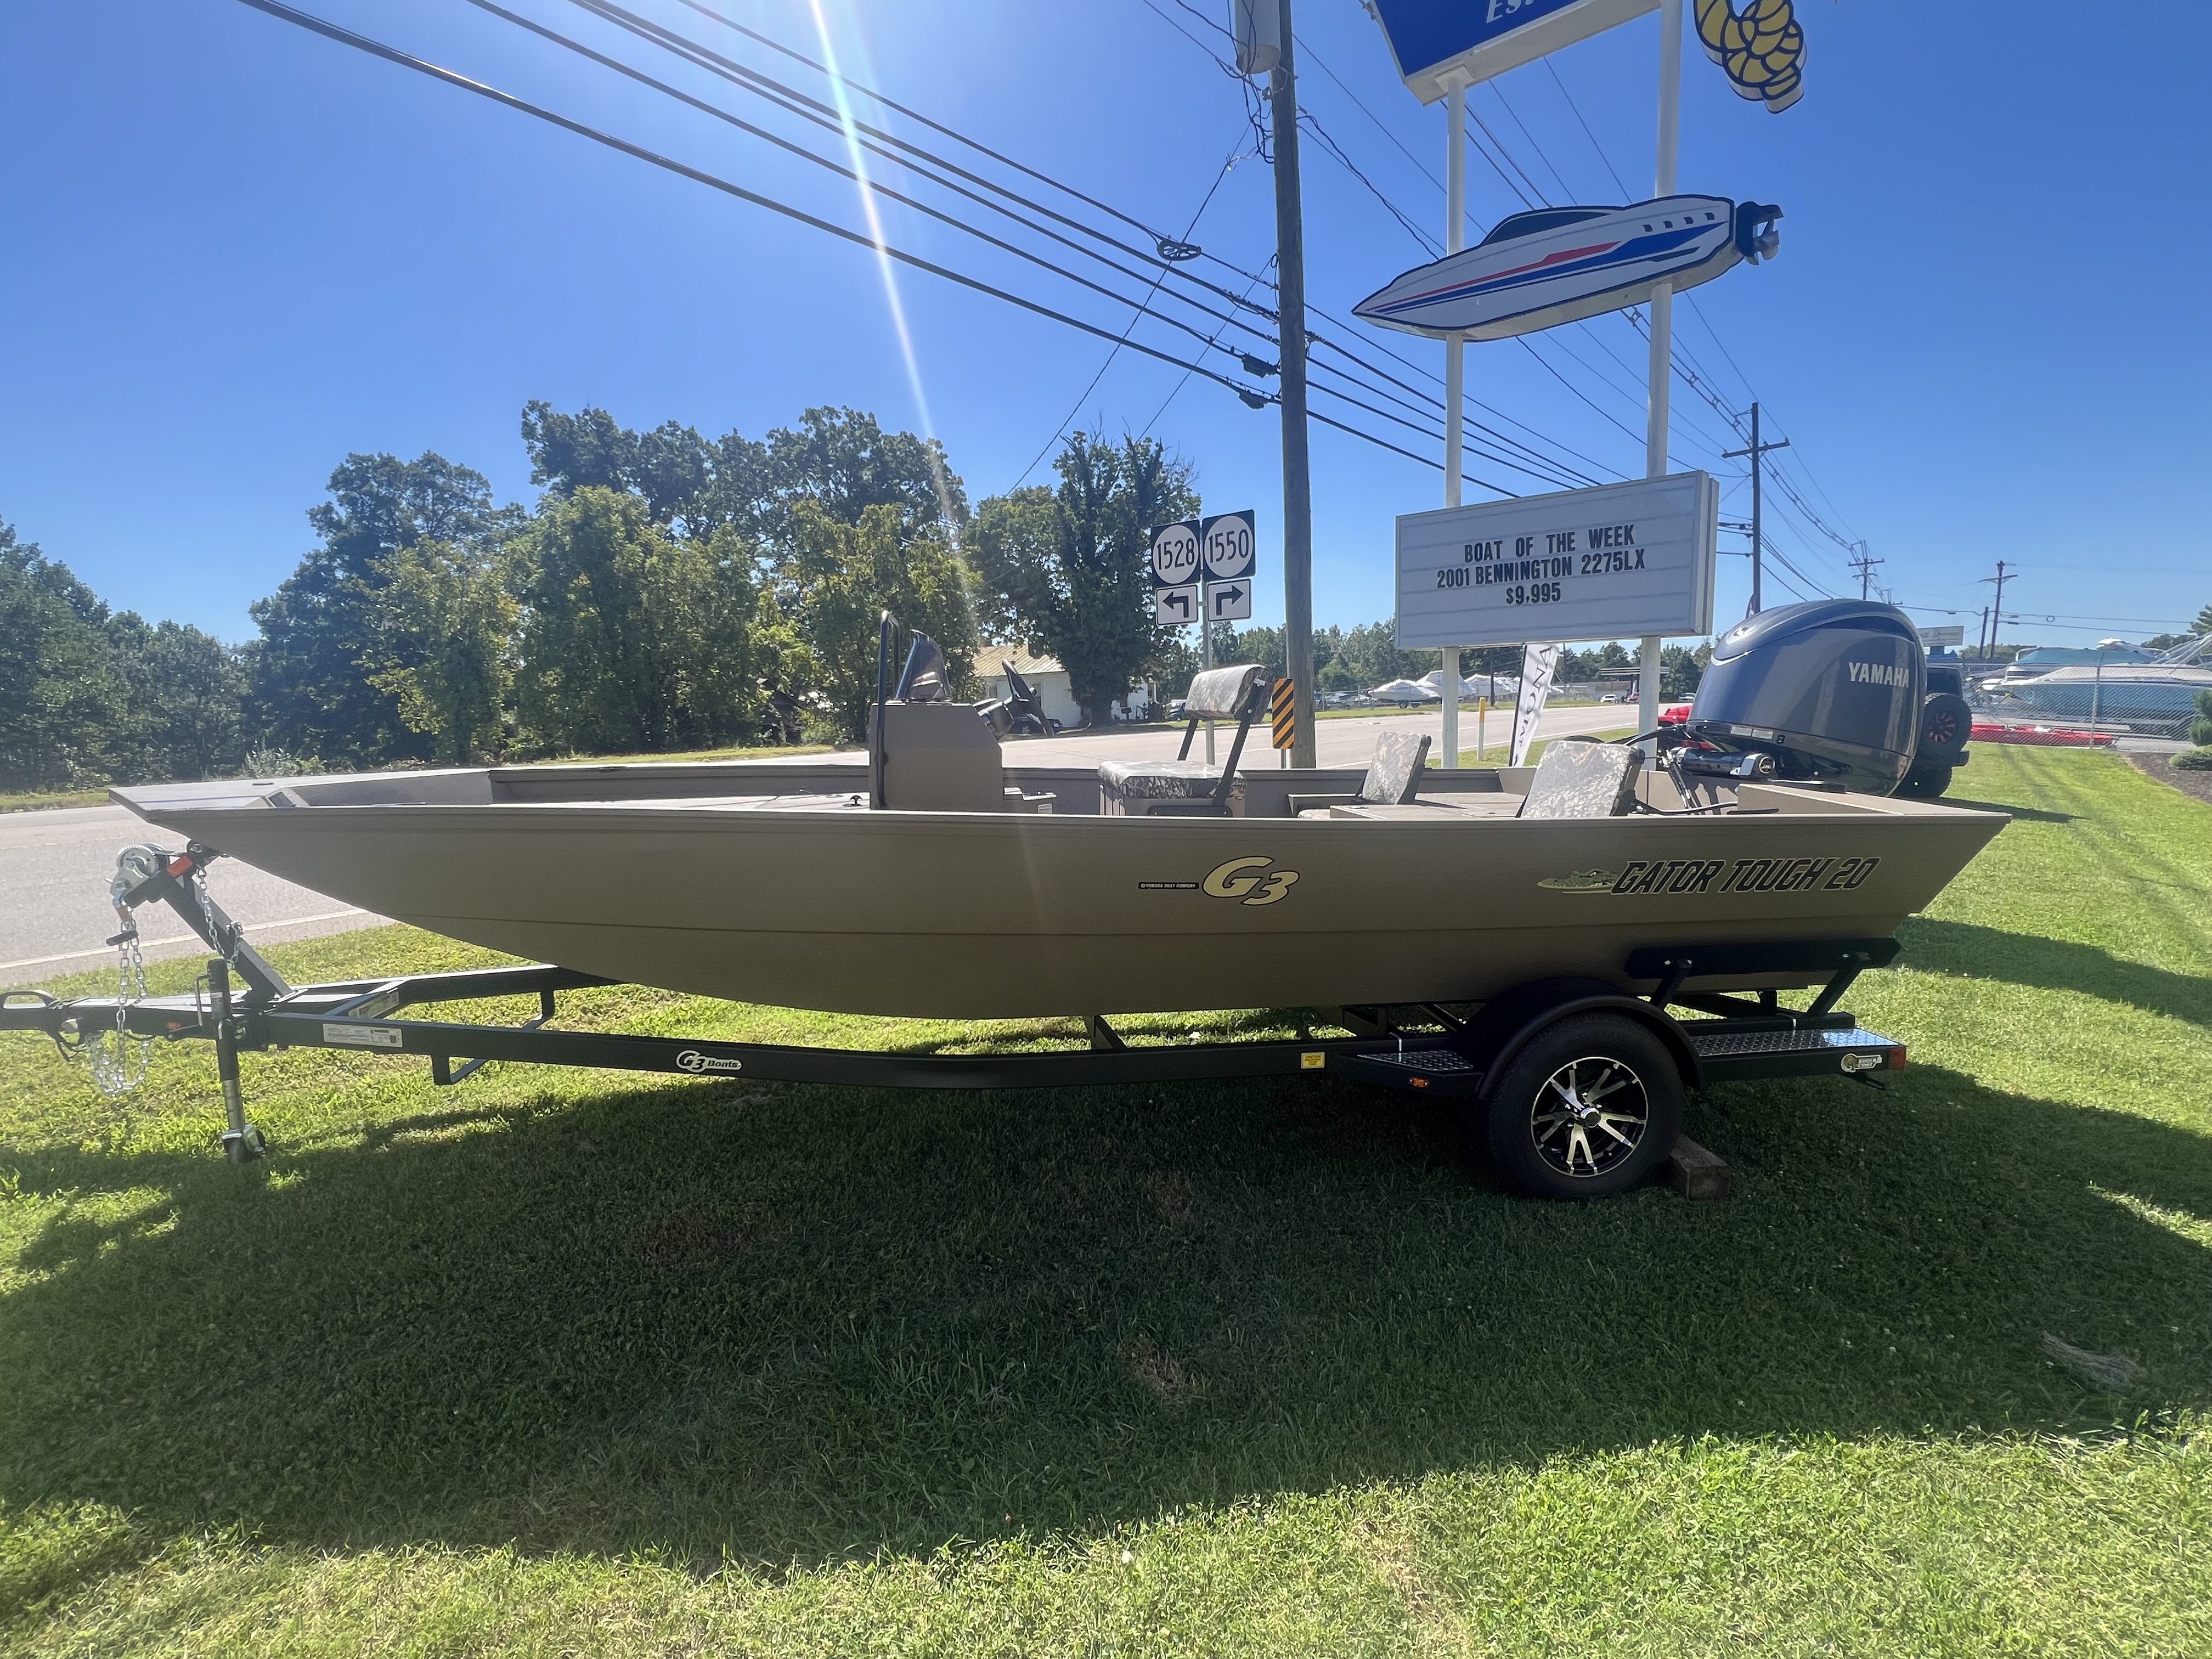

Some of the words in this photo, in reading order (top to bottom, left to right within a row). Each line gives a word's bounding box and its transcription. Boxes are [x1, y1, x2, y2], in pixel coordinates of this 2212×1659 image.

[1157, 538, 1195, 570] 1528
[1209, 529, 1249, 563] 1550
[1465, 540, 1503, 563] BOAT
[1515, 537, 1533, 557] OF
[1546, 532, 1576, 554] THE
[1588, 524, 1635, 549] WEEK
[1437, 568, 1470, 588] 2001
[1475, 556, 1572, 585] BENNINGTON
[1581, 549, 1645, 574] 2275LX
[1505, 582, 1561, 605] $9,995
[1848, 662, 1909, 688] YAMAHA
[1202, 855, 1300, 906] G3
[1611, 860, 1726, 895] GATOR
[1717, 857, 1841, 894] TOUGH
[1820, 857, 1882, 891] 20
[676, 1050, 706, 1073] G3
[708, 1059, 738, 1068] Boats
